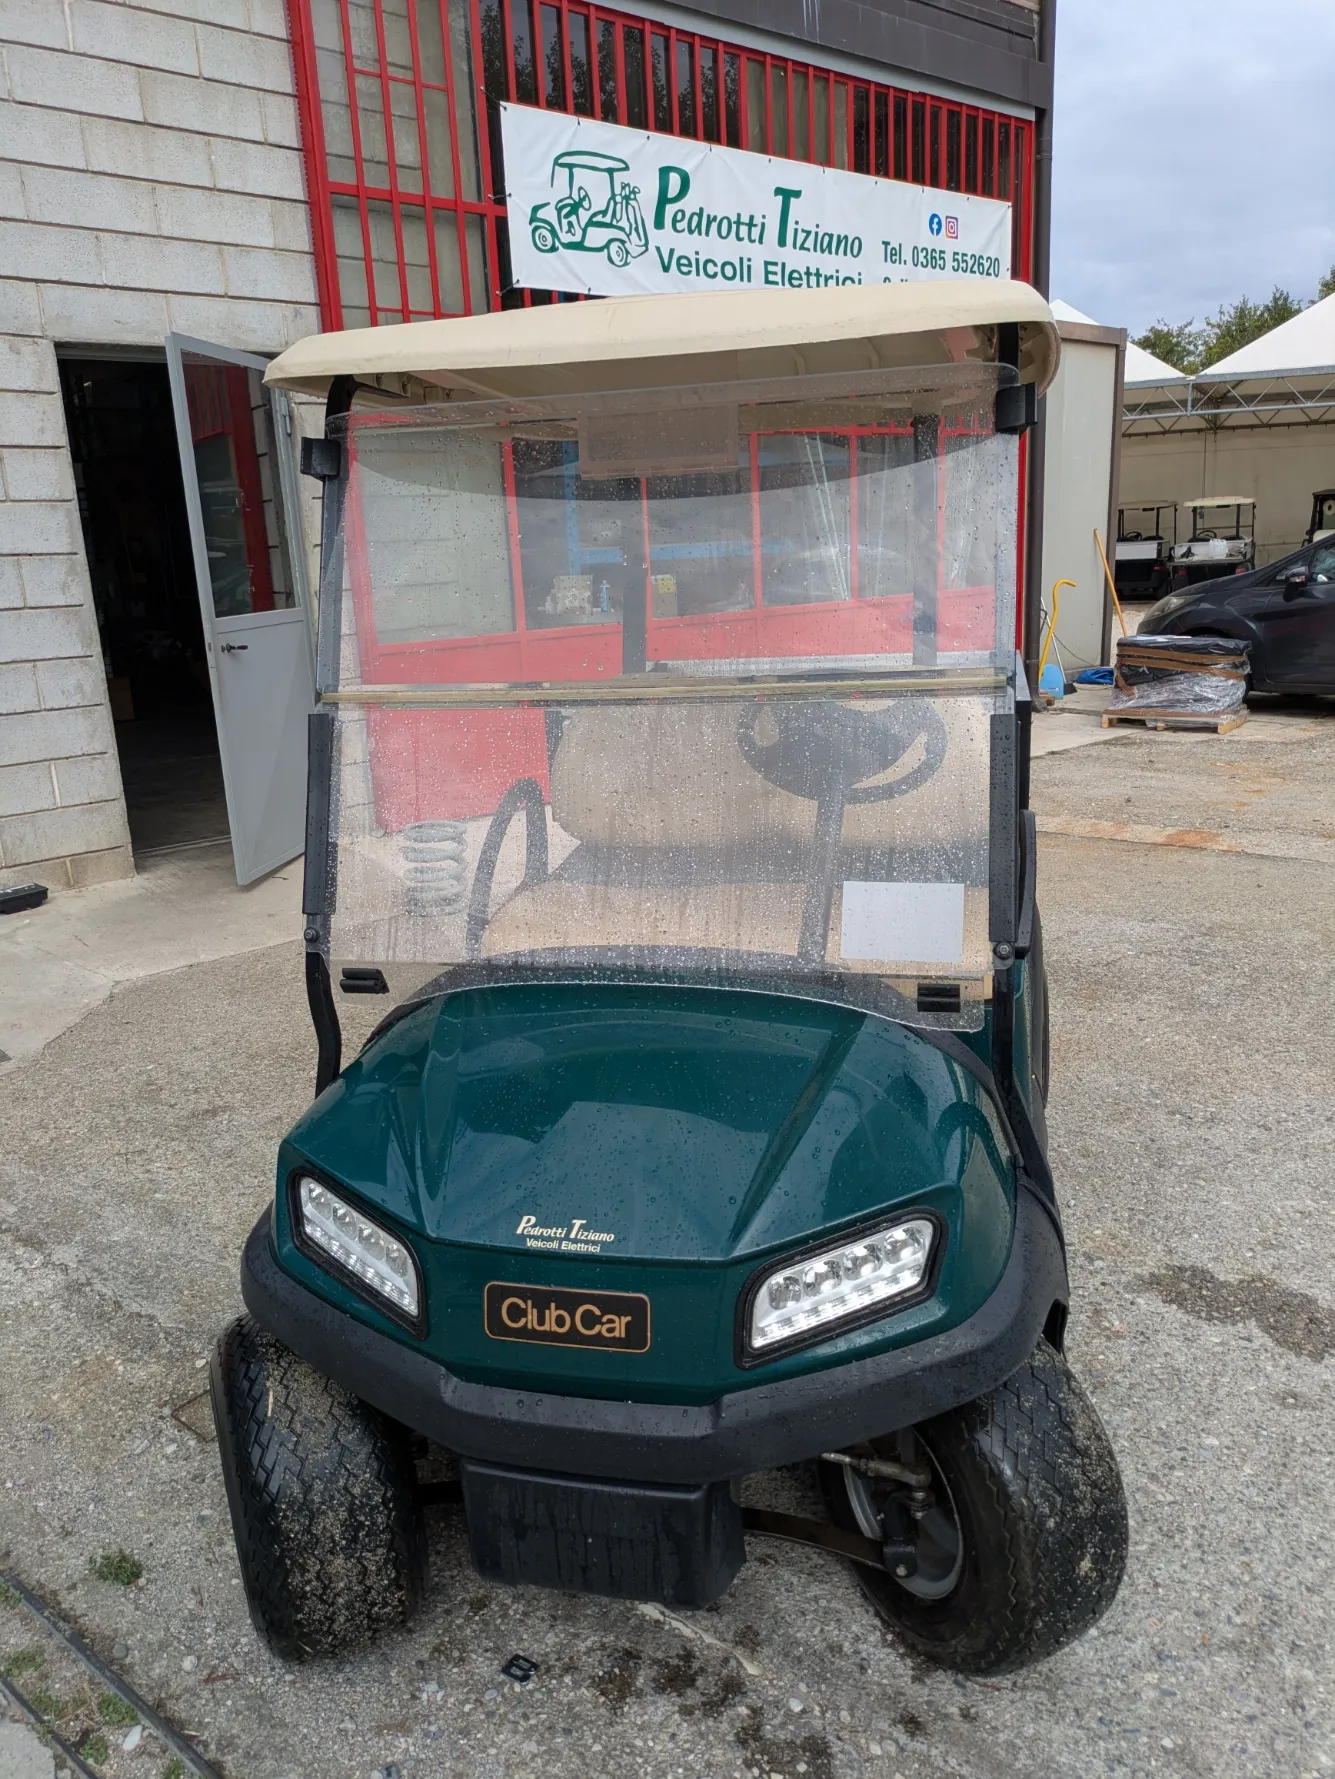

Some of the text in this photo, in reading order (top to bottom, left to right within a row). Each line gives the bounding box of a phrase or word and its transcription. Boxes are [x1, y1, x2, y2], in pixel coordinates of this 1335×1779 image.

[653, 165, 864, 259] Pedrotti Tiziano
[654, 245, 752, 283] Veicoli
[881, 240, 1000, 278] Tel. 0365 552620
[516, 1215, 615, 1242] Pedrotti Tiziano
[526, 1238, 601, 1253] Veicoli Elettrici
[501, 1297, 632, 1338] Club Car
